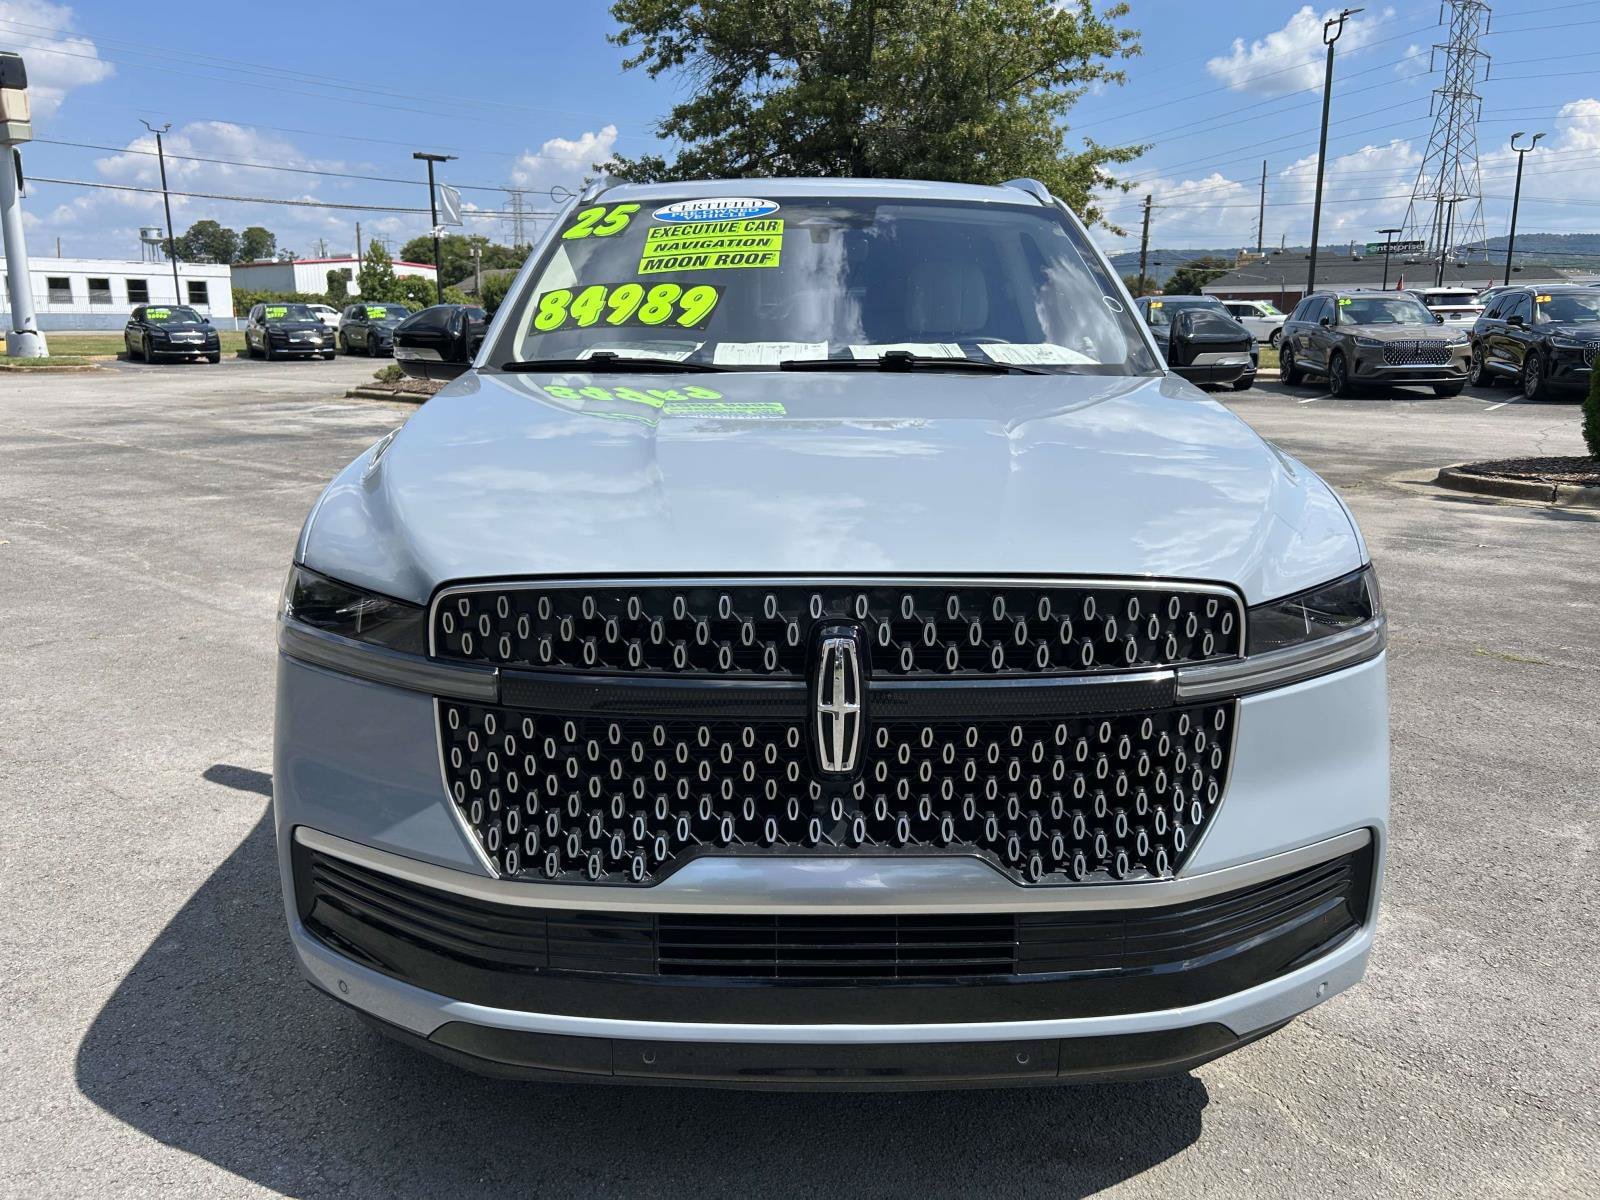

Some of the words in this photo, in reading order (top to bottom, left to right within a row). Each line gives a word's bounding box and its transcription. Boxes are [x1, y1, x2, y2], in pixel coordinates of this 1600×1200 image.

[668, 201, 765, 212] CERTIFIED
[562, 204, 641, 240] 25
[650, 222, 740, 238] EXECUTIVE
[744, 221, 778, 232] CAR
[653, 238, 771, 252] NAVIGATION
[1370, 243, 1423, 252] enterprise
[643, 255, 709, 270] MOON
[714, 252, 774, 266] ROOF
[534, 283, 719, 331] 84989
